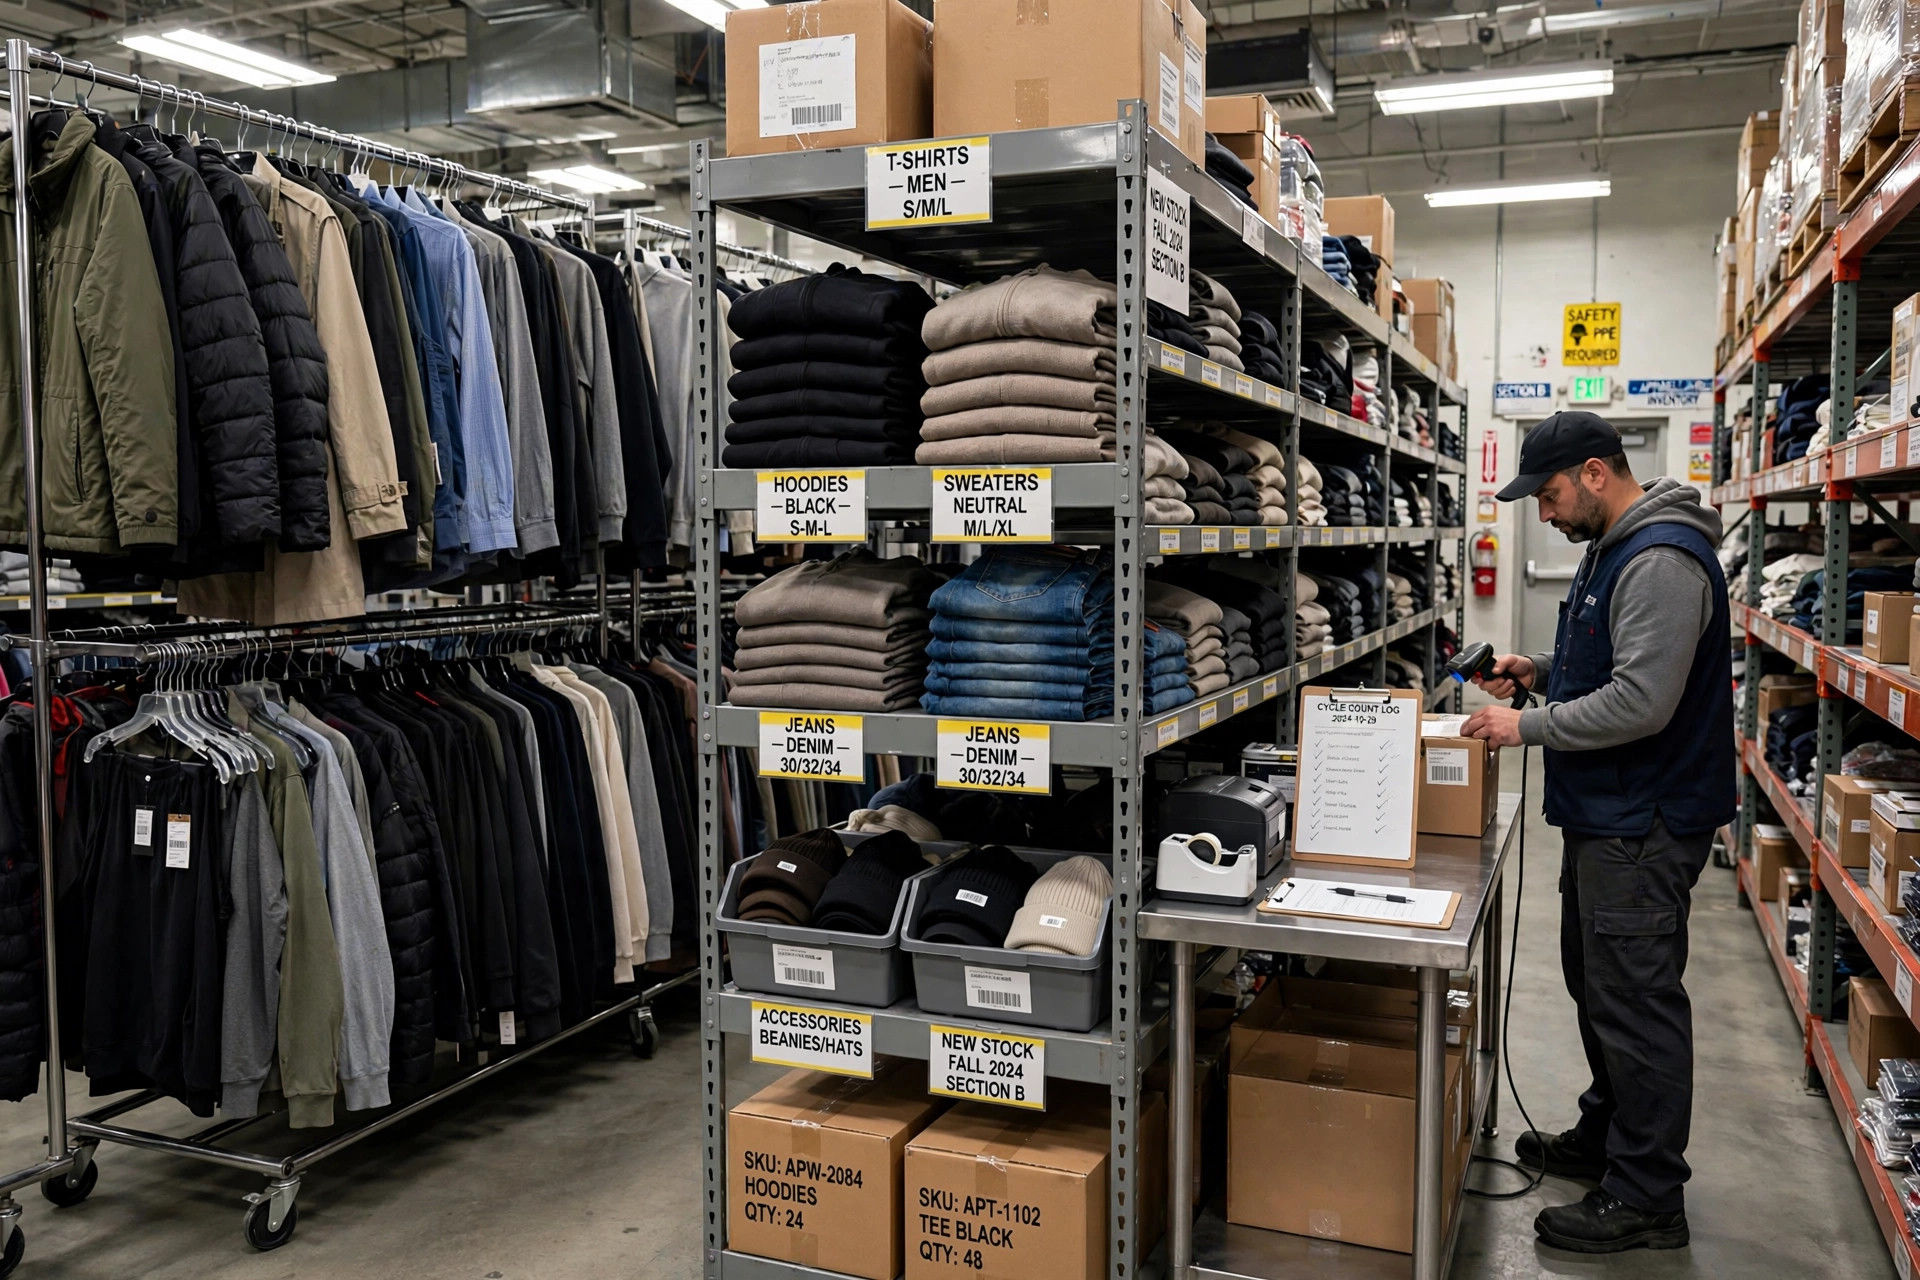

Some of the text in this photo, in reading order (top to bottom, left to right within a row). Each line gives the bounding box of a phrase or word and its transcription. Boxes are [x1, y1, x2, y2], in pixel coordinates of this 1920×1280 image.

[886, 145, 969, 171] T-SHIRTS
[903, 197, 952, 219] S/M/L
[1150, 186, 1187, 228] NEW STOCK
[1153, 218, 1183, 254] FALL 2024
[1151, 247, 1185, 284] SECTION B
[1568, 307, 1617, 322] SAFETY
[1593, 326, 1617, 340] PPE
[1574, 377, 1605, 400] EXIT
[774, 475, 848, 493] HOODIES
[943, 473, 1039, 492] SWEATERS
[953, 496, 1027, 514] NEUTRAL
[790, 519, 832, 537] S-M-L
[963, 519, 1017, 537] M/L/XL
[1317, 702, 1400, 714] CYCLE COUNT LOG
[785, 717, 835, 734] JEANS
[965, 725, 1020, 744] JEANS
[780, 757, 842, 776] 30/32/34
[959, 767, 1026, 788] 30/32/34
[759, 1008, 862, 1035] ACCESSORIES
[760, 1029, 863, 1057] BEANIES/HATS
[942, 1033, 1034, 1060] NEW STOCK
[949, 1054, 1024, 1080] FALL 2024
[946, 1075, 1025, 1101] SECTION B
[744, 1150, 863, 1189] SKU: APW-2084
[745, 1175, 817, 1206] HOODIES
[744, 1201, 804, 1230] QTY: 24
[919, 1187, 1041, 1227] SKU: APT-1102
[919, 1214, 1014, 1249] TEE BLACK
[919, 1241, 983, 1271] QTY: 48
